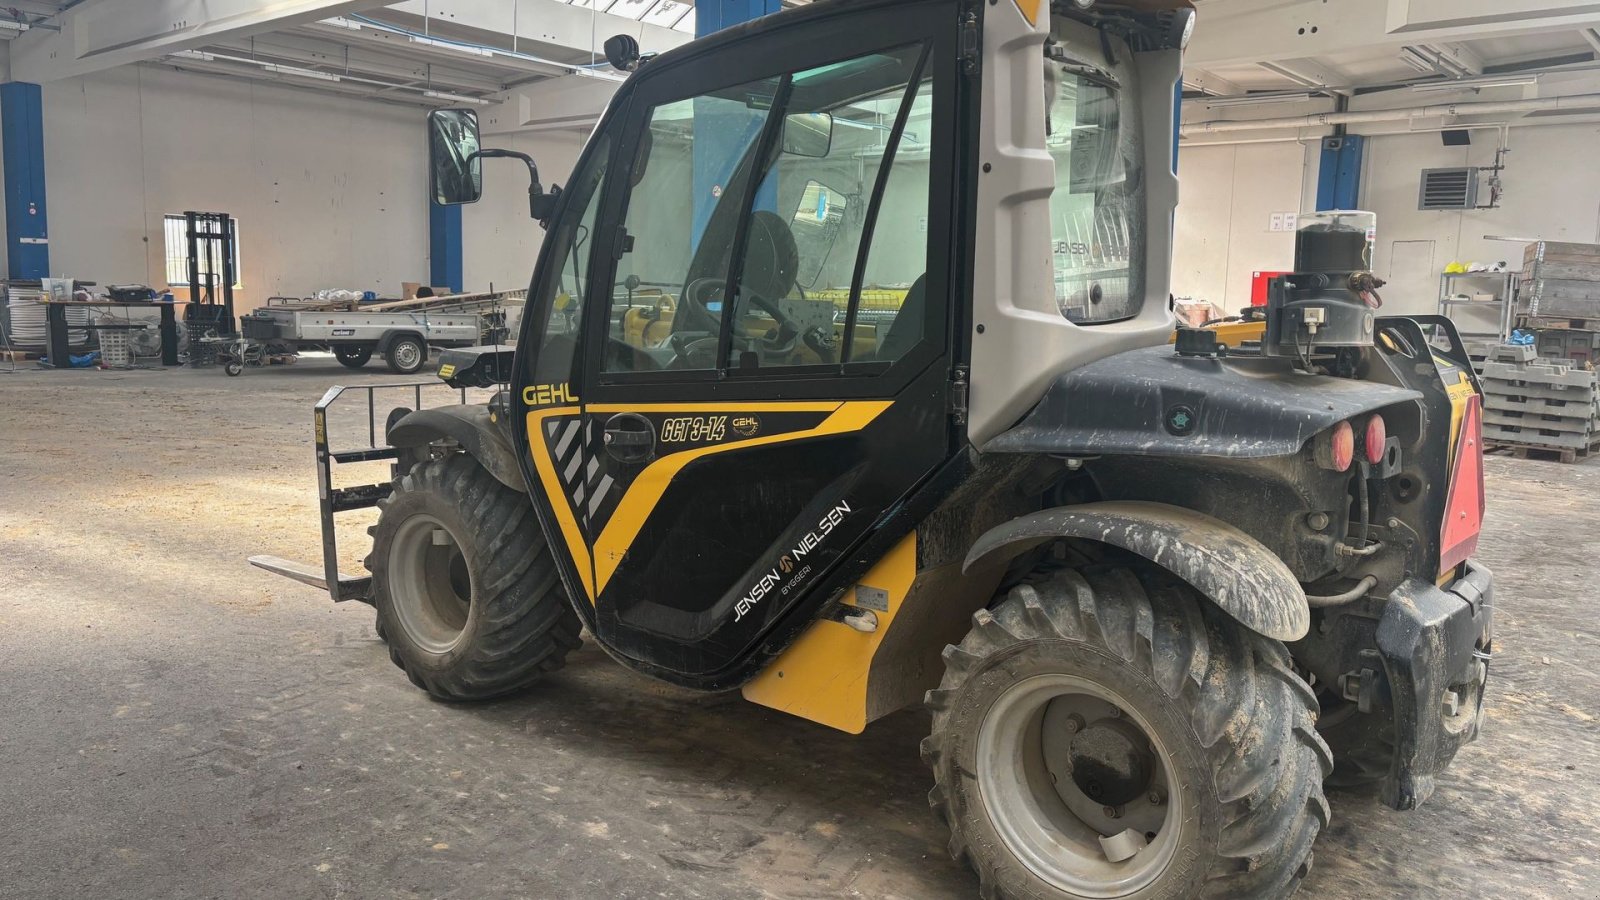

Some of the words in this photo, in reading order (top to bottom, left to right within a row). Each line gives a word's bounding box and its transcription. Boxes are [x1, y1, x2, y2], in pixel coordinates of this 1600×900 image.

[1054, 241, 1090, 255] JENSEN
[522, 382, 580, 406] GEHL
[690, 415, 728, 441] 3-14
[732, 417, 758, 427] GEHL
[734, 568, 781, 622] JENSEN
[791, 500, 851, 561] NIELSEN
[781, 565, 811, 595] BYGGERI
